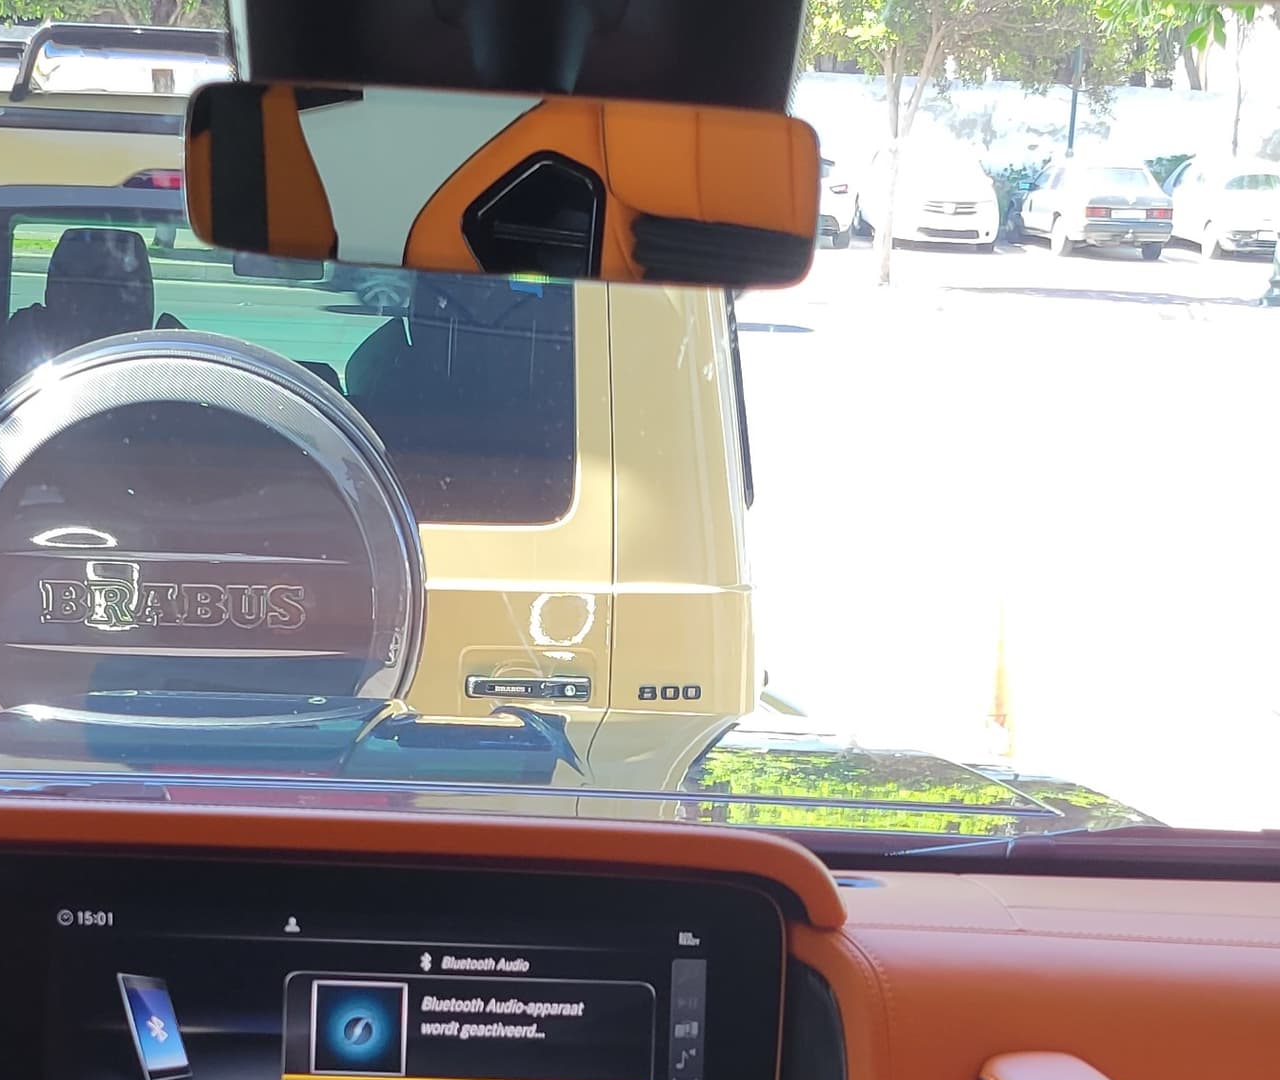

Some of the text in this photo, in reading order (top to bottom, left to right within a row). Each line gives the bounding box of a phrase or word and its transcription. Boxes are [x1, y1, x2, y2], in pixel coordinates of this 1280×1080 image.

[39, 579, 306, 629] BRABUS
[638, 686, 701, 700] 800
[77, 910, 113, 926] 15:01
[441, 956, 530, 972] Bluetooth Audio
[421, 996, 585, 1018] Bluetooth Audio-apparaat
[421, 1020, 546, 1039] wordt geactiveerd...
